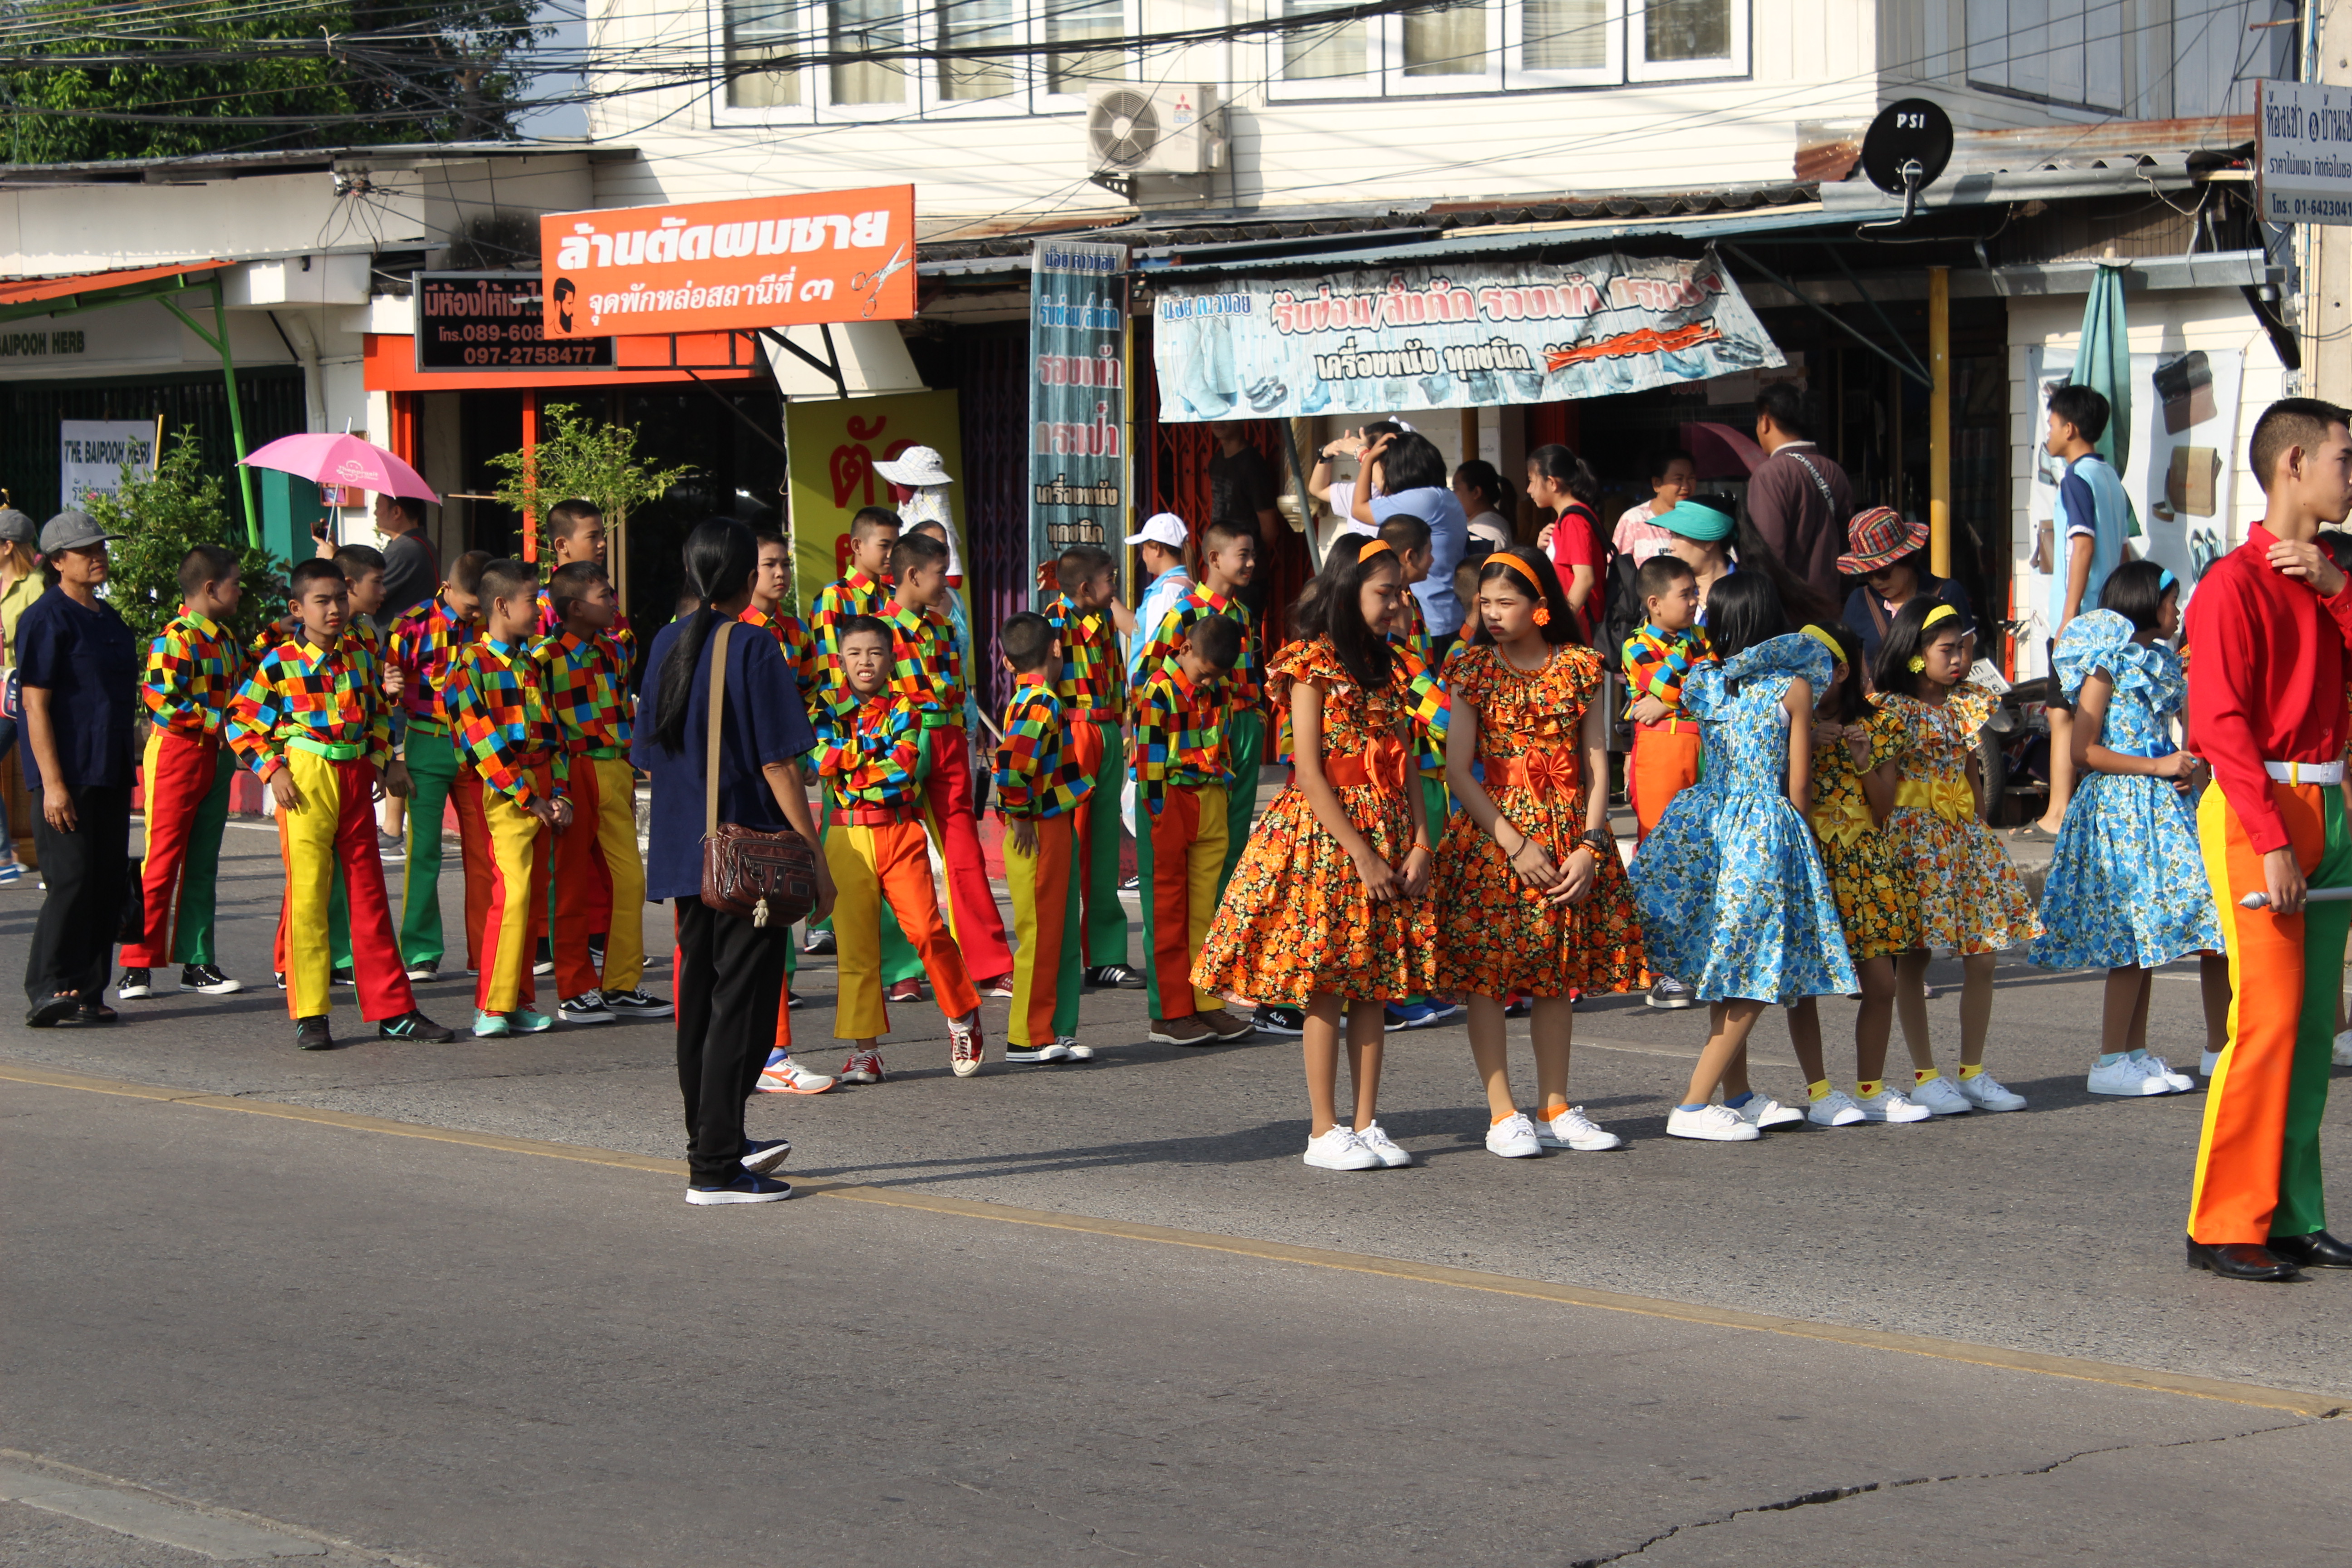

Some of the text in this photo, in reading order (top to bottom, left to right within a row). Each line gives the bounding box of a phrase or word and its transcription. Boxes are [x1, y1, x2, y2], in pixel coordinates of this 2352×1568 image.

[1896, 113, 1924, 128] PSI
[2266, 91, 2303, 139] ห้องเช่า
[2321, 94, 2352, 142] บ้านเช่
[2270, 151, 2352, 177] ราคาไม่แพง ติดต่อในซอ
[2272, 194, 2290, 215] โทร.
[1072, 254, 1117, 271] คาวบอย
[589, 266, 834, 326] จุดพักหล่อสถานีที่ ๓
[1479, 273, 1611, 322] รองเท้า
[0, 331, 84, 356] AIPOOH HERB
[464, 347, 596, 364] 097-2758477
[1315, 336, 1439, 380] เครื่องหนัง
[1443, 336, 1534, 382] ทุกชนิด
[1036, 344, 1122, 389] รองเท้า
[1035, 401, 1120, 458] กระเป๋า
[64, 440, 82, 463] THE
[85, 441, 124, 464] BAIPOOH
[1034, 473, 1119, 507] เครื่องหนัง
[1047, 519, 1105, 551] ทุกชนิด
